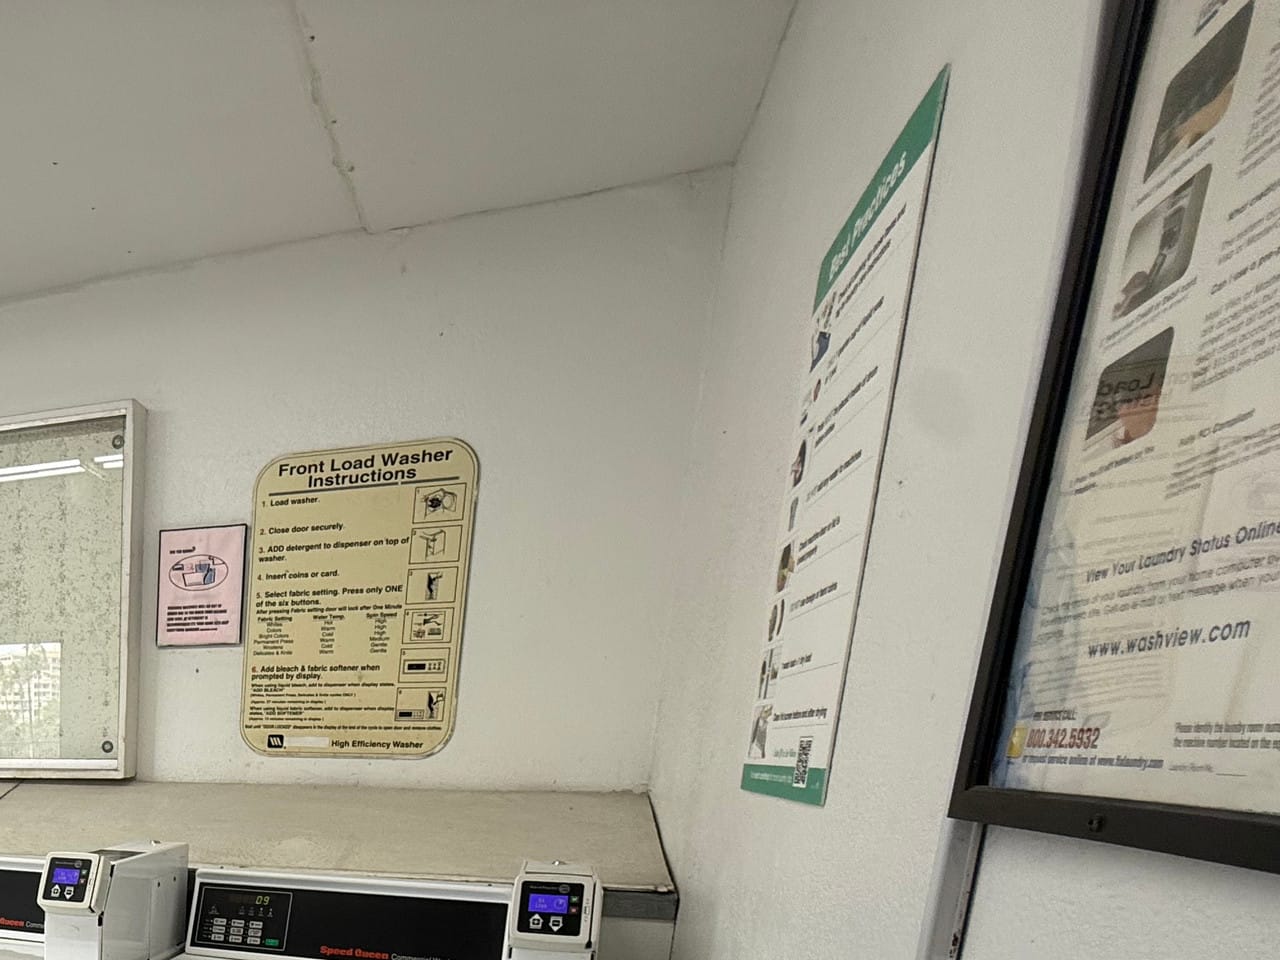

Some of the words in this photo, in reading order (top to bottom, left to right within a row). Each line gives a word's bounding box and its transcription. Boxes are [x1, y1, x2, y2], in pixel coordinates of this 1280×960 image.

[828, 232, 852, 283] Best
[850, 151, 907, 247] Practices
[278, 462, 325, 477] Front
[330, 455, 375, 472] Load
[381, 449, 453, 467] Washer
[308, 468, 417, 488] Instructions
[270, 498, 289, 507] Load
[268, 527, 290, 535] Close
[267, 545, 285, 553] ADD
[286, 543, 322, 552] detergent
[333, 539, 371, 549] dispenser
[385, 537, 399, 545] top
[401, 536, 410, 545] of
[1086, 569, 1109, 583] View
[1112, 560, 1136, 577] Your
[1138, 547, 1186, 570] Laundry
[1189, 534, 1230, 557] Status
[265, 571, 287, 580] Insert
[288, 571, 309, 579] coins
[264, 591, 287, 599] Select
[342, 587, 364, 595] Press
[366, 586, 383, 595] only
[385, 585, 403, 593] ONE
[255, 600, 264, 608] of
[1088, 619, 1251, 658] www.washview.com
[260, 665, 275, 673] Add
[276, 665, 300, 673] bleach
[329, 664, 359, 672] softener
[251, 673, 284, 681] prompted
[285, 673, 294, 681] by
[331, 740, 350, 749] High
[351, 740, 391, 750] Efficiency
[392, 741, 423, 749] Washer
[320, 945, 353, 956] Speed
[355, 948, 389, 960] Queen
